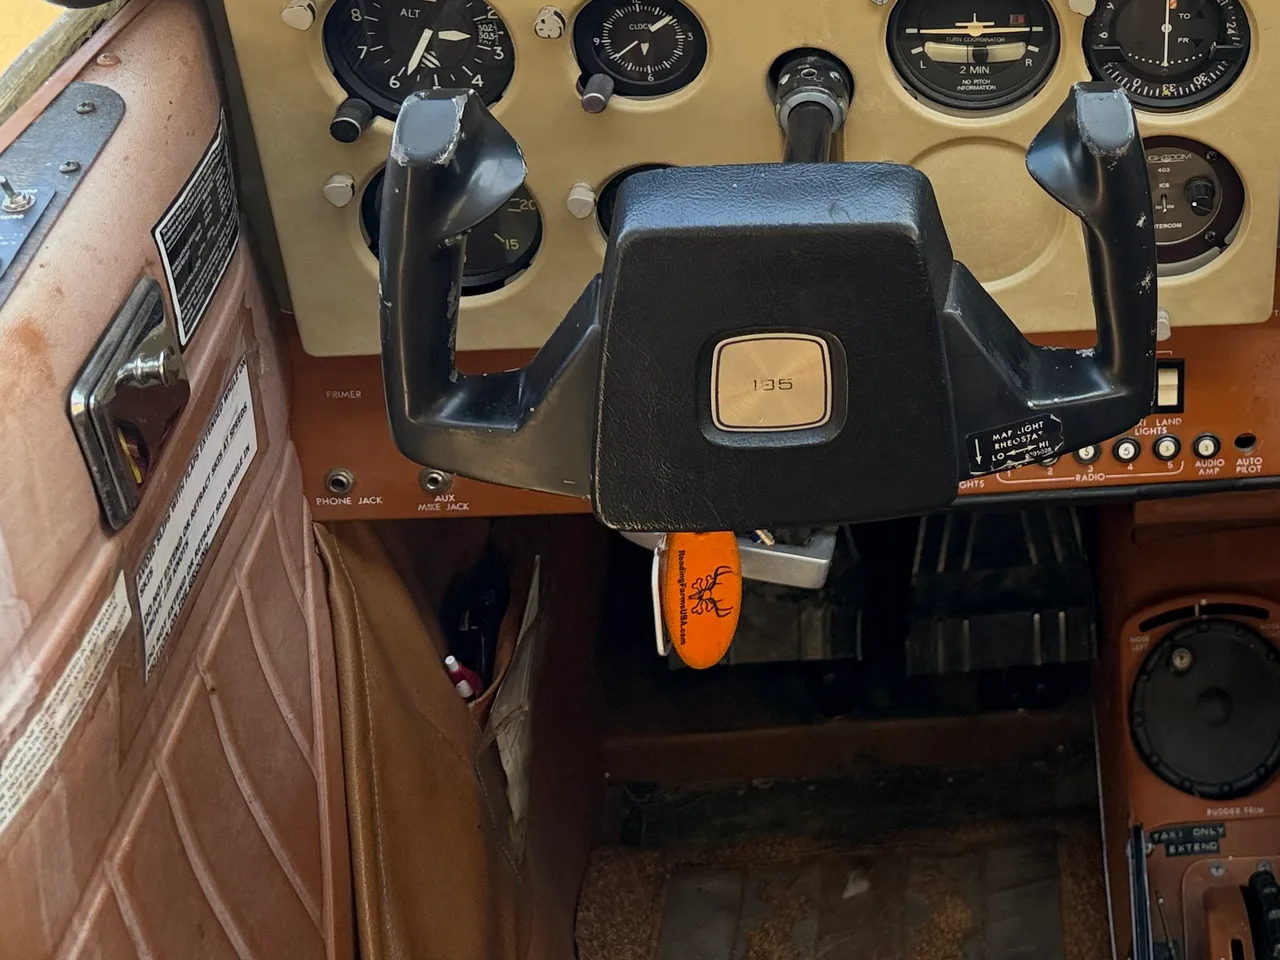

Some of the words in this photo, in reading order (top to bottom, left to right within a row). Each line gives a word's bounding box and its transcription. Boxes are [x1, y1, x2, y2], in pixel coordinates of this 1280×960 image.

[400, 8, 420, 18] ALT
[326, 391, 362, 399] PRIMER
[1156, 418, 1182, 426] LAND
[1134, 427, 1168, 435] LIGHTS
[992, 453, 1005, 461] LO
[1236, 457, 1263, 465] AUTO
[1195, 459, 1225, 467] AUDIO
[1236, 465, 1261, 473] PILOT
[1075, 473, 1105, 481] RADIO
[316, 497, 352, 506] PHONE
[358, 496, 383, 505] JACK
[434, 494, 455, 502] AUX
[418, 503, 441, 512] MIKE
[446, 503, 470, 511] JACK
[678, 550, 687, 645] ReadingFarmsUSA.com
[1207, 806, 1241, 816] RUDDER
[1244, 806, 1265, 815] TRIM
[1153, 831, 1183, 840] TAXI
[1192, 827, 1224, 837] ONLY
[1169, 842, 1218, 854] EXTEND
